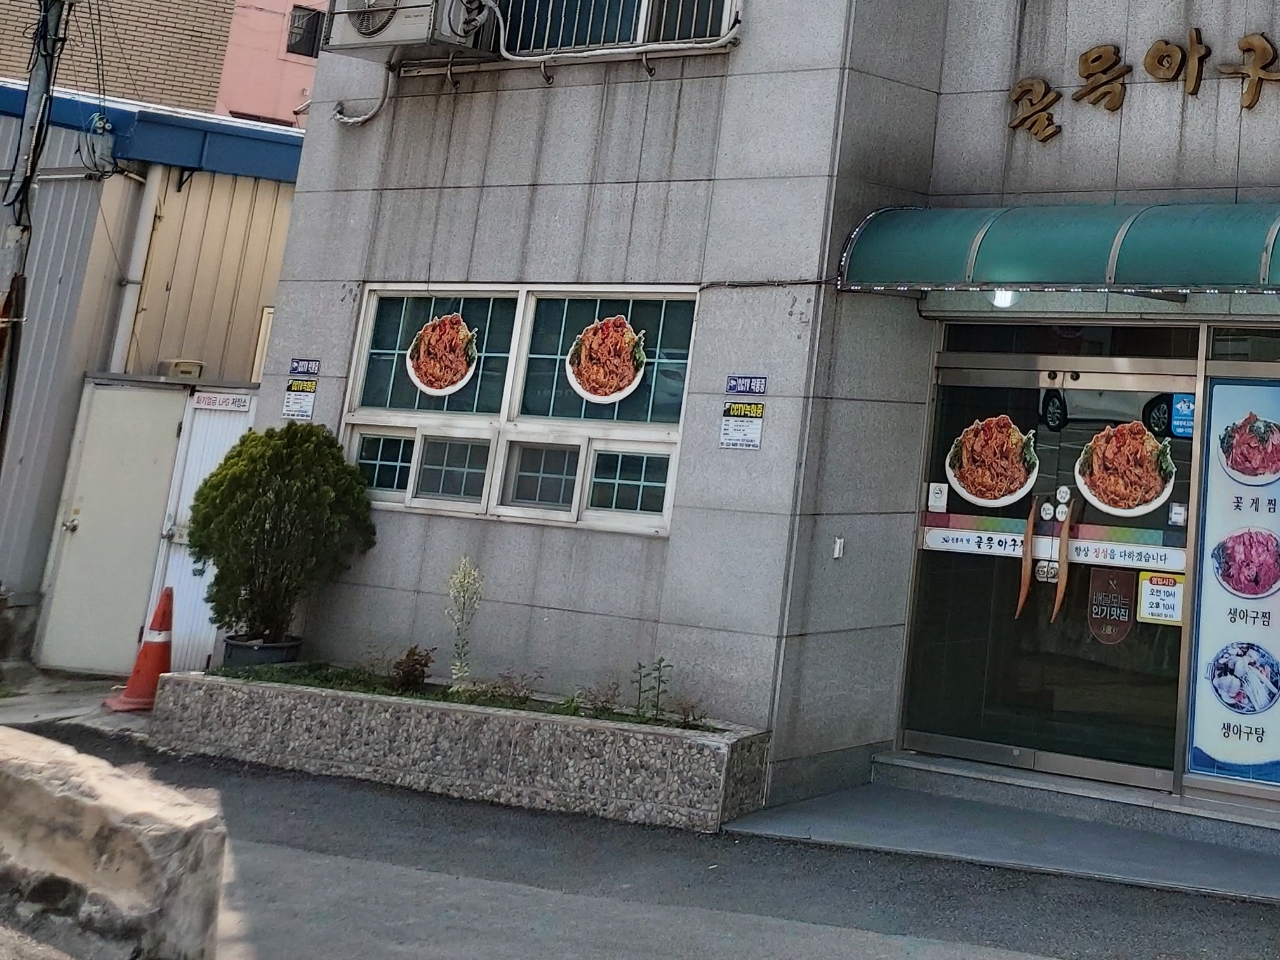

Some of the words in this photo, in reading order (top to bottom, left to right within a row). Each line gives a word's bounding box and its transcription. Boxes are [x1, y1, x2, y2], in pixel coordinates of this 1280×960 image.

[218, 397, 230, 406] LPG
[1074, 546, 1090, 557] 항상
[1119, 549, 1168, 565] 다하겠습니다
[1151, 576, 1175, 587] 영업시간
[1092, 591, 1130, 608] 배달되는
[1149, 587, 1162, 596] 오전
[1163, 590, 1176, 598] 10시
[1092, 605, 1129, 622] 인기맛집
[1162, 603, 1175, 611] 10시
[1227, 607, 1271, 627] 생아구찜
[1220, 722, 1266, 743] 생아구탕
